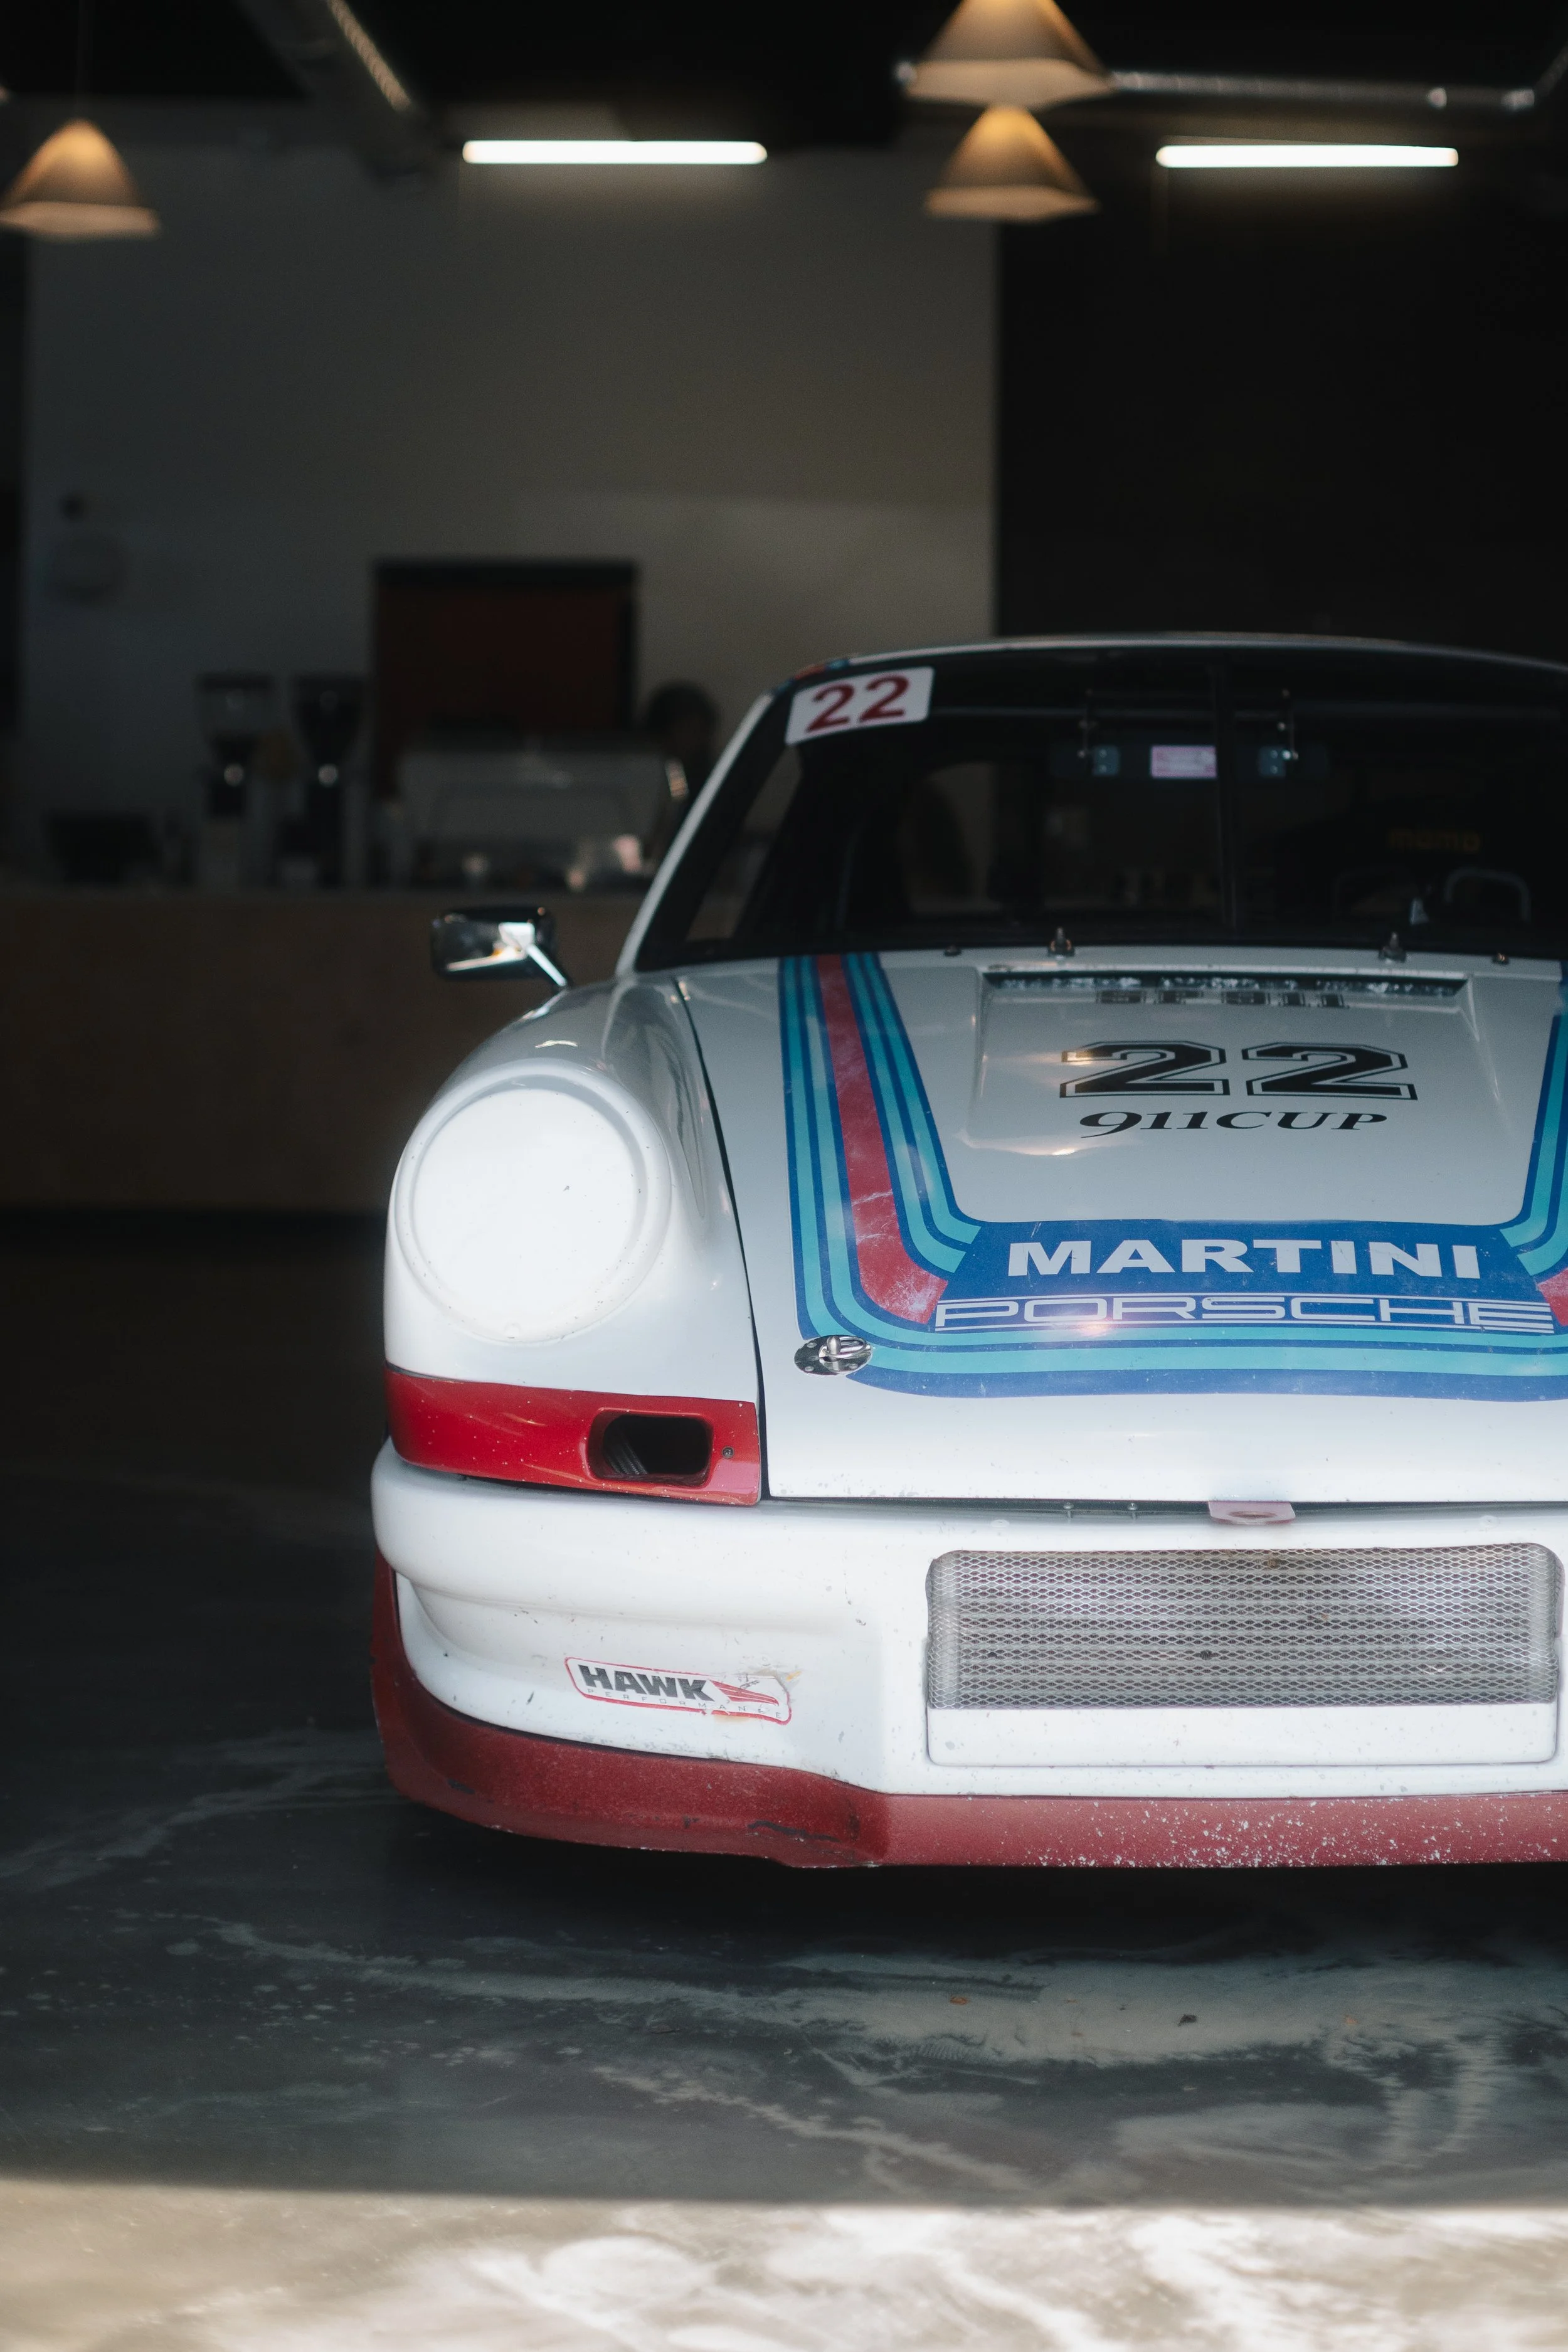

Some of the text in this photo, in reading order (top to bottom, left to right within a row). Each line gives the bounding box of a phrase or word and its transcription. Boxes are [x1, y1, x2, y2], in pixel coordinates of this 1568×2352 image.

[806, 675, 909, 734] 22
[1059, 1041, 1418, 1101] 22
[1007, 1239, 1481, 1279] MARTINI
[935, 1297, 1554, 1330] PORSCHE
[577, 1664, 715, 1702] HAWK
